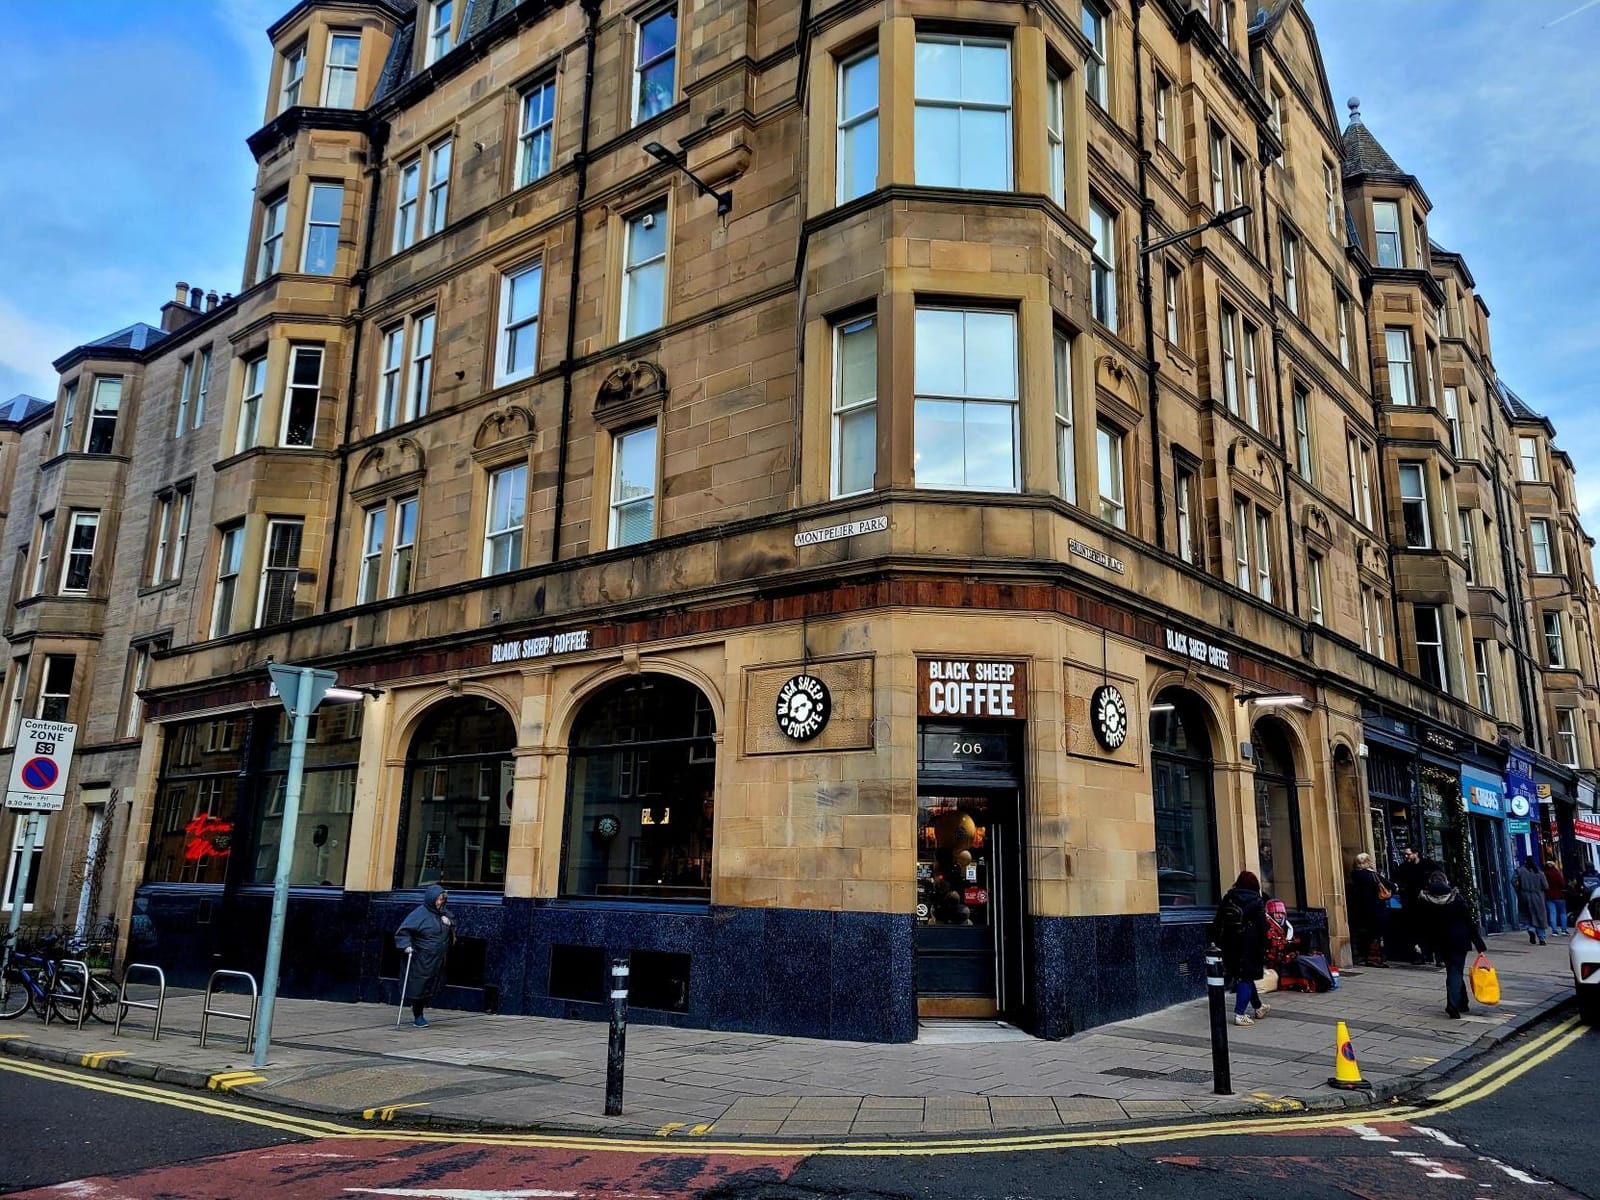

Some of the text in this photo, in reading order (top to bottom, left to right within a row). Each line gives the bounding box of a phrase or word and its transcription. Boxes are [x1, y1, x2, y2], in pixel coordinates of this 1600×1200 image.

[797, 517, 887, 544] MONTPELIER PARK
[492, 629, 588, 663] BLACK SHEEP COFFEE
[1166, 628, 1230, 671] BLACK SHEEP COFFEE
[929, 661, 1015, 681] BLACK SHEEP
[777, 676, 824, 715] BLACK SHEEP
[929, 681, 1016, 716] COFFEE
[1098, 686, 1126, 721] BLACK SHEEP
[25, 720, 74, 733] Controlled
[30, 730, 65, 742] ZONE
[787, 711, 823, 738] COFFEE
[1105, 724, 1126, 747] COFFEE
[37, 743, 54, 754] S3
[952, 742, 983, 755] 206
